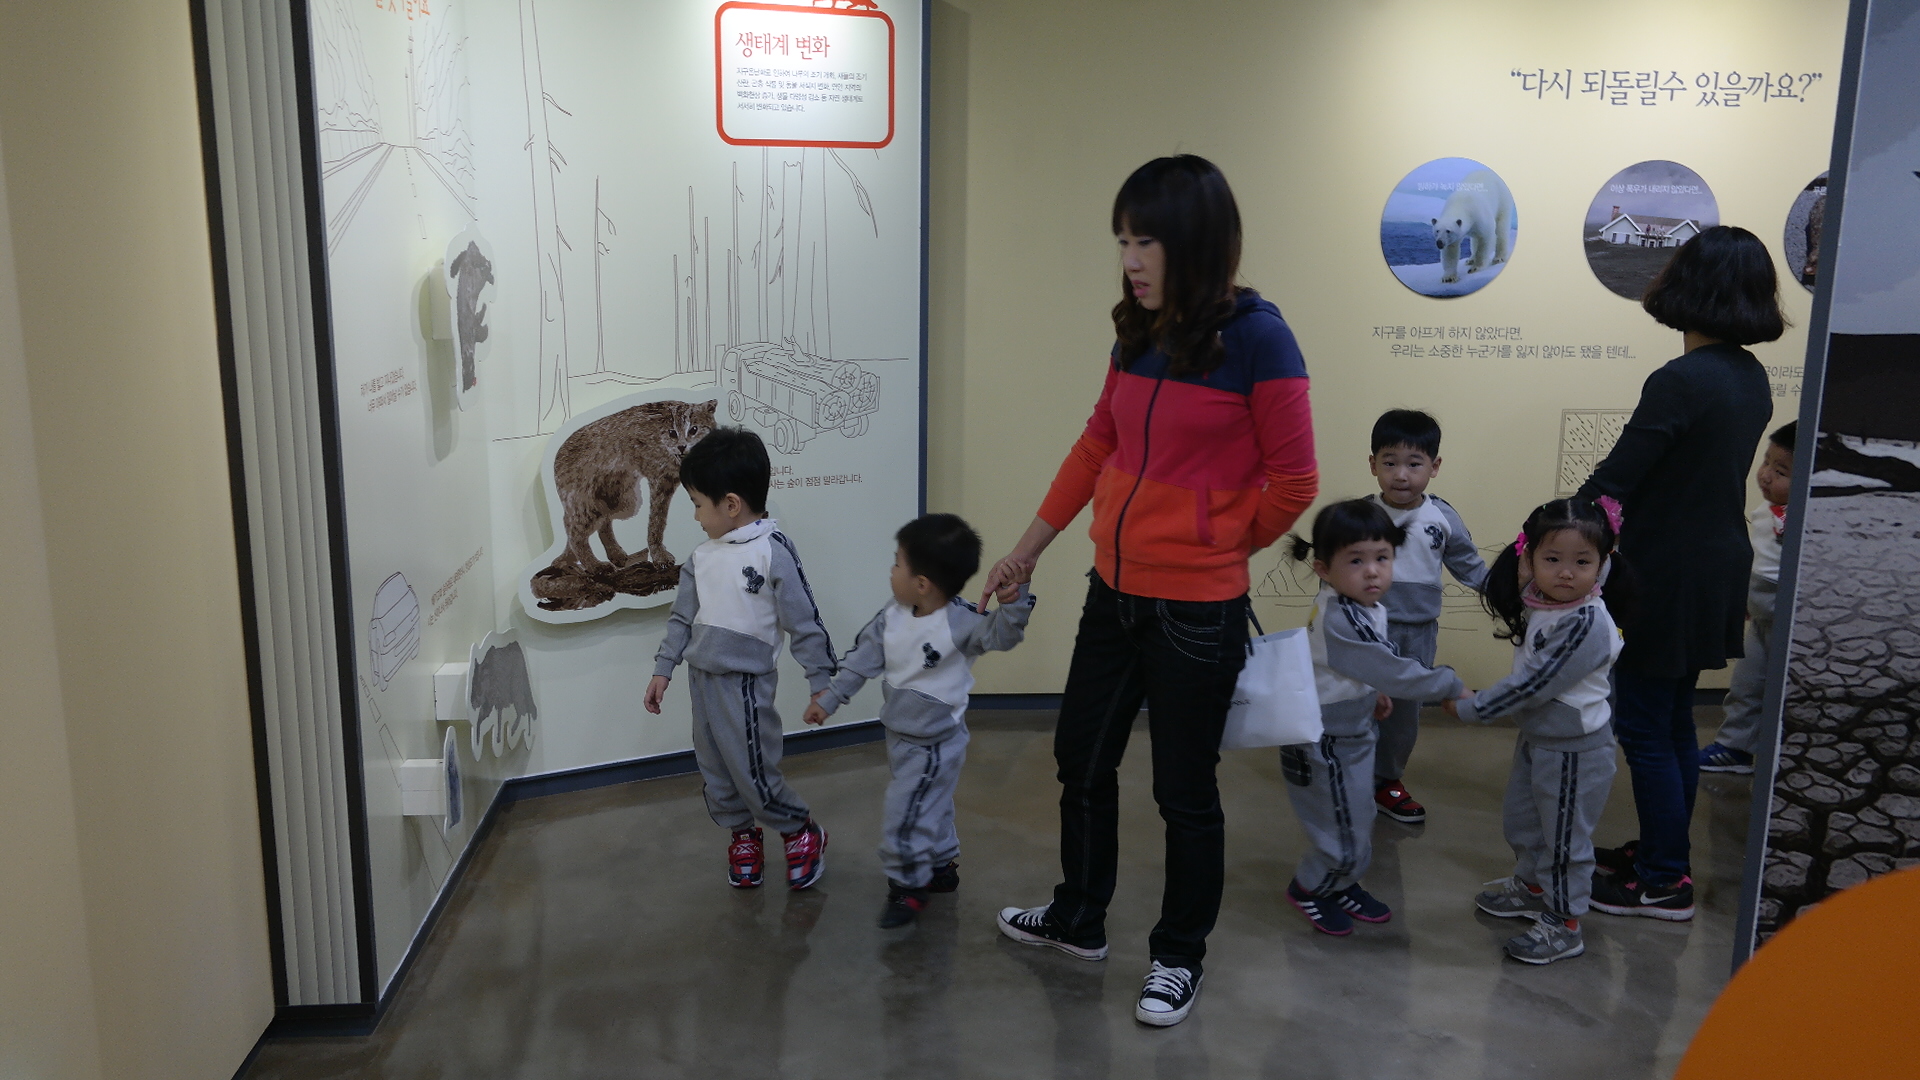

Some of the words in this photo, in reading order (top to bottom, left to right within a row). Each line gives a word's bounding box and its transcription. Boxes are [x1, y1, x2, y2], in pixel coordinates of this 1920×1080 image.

[735, 32, 789, 58] 생태계
[795, 34, 830, 60] 변화
[1581, 69, 1687, 106] 되돌릴수
[1372, 326, 1407, 340] 지구를
[1410, 326, 1445, 340] 아프게
[1448, 326, 1471, 340] 하지
[1390, 345, 1425, 358] 우리는
[1428, 345, 1463, 358] 소중한
[1466, 345, 1512, 359] 누군가를
[1516, 345, 1538, 360] 잃지
[1542, 345, 1576, 360] 않아도
[1580, 346, 1602, 360] 됐을
[787, 477, 803, 488] 숲이
[805, 476, 821, 487] 점점
